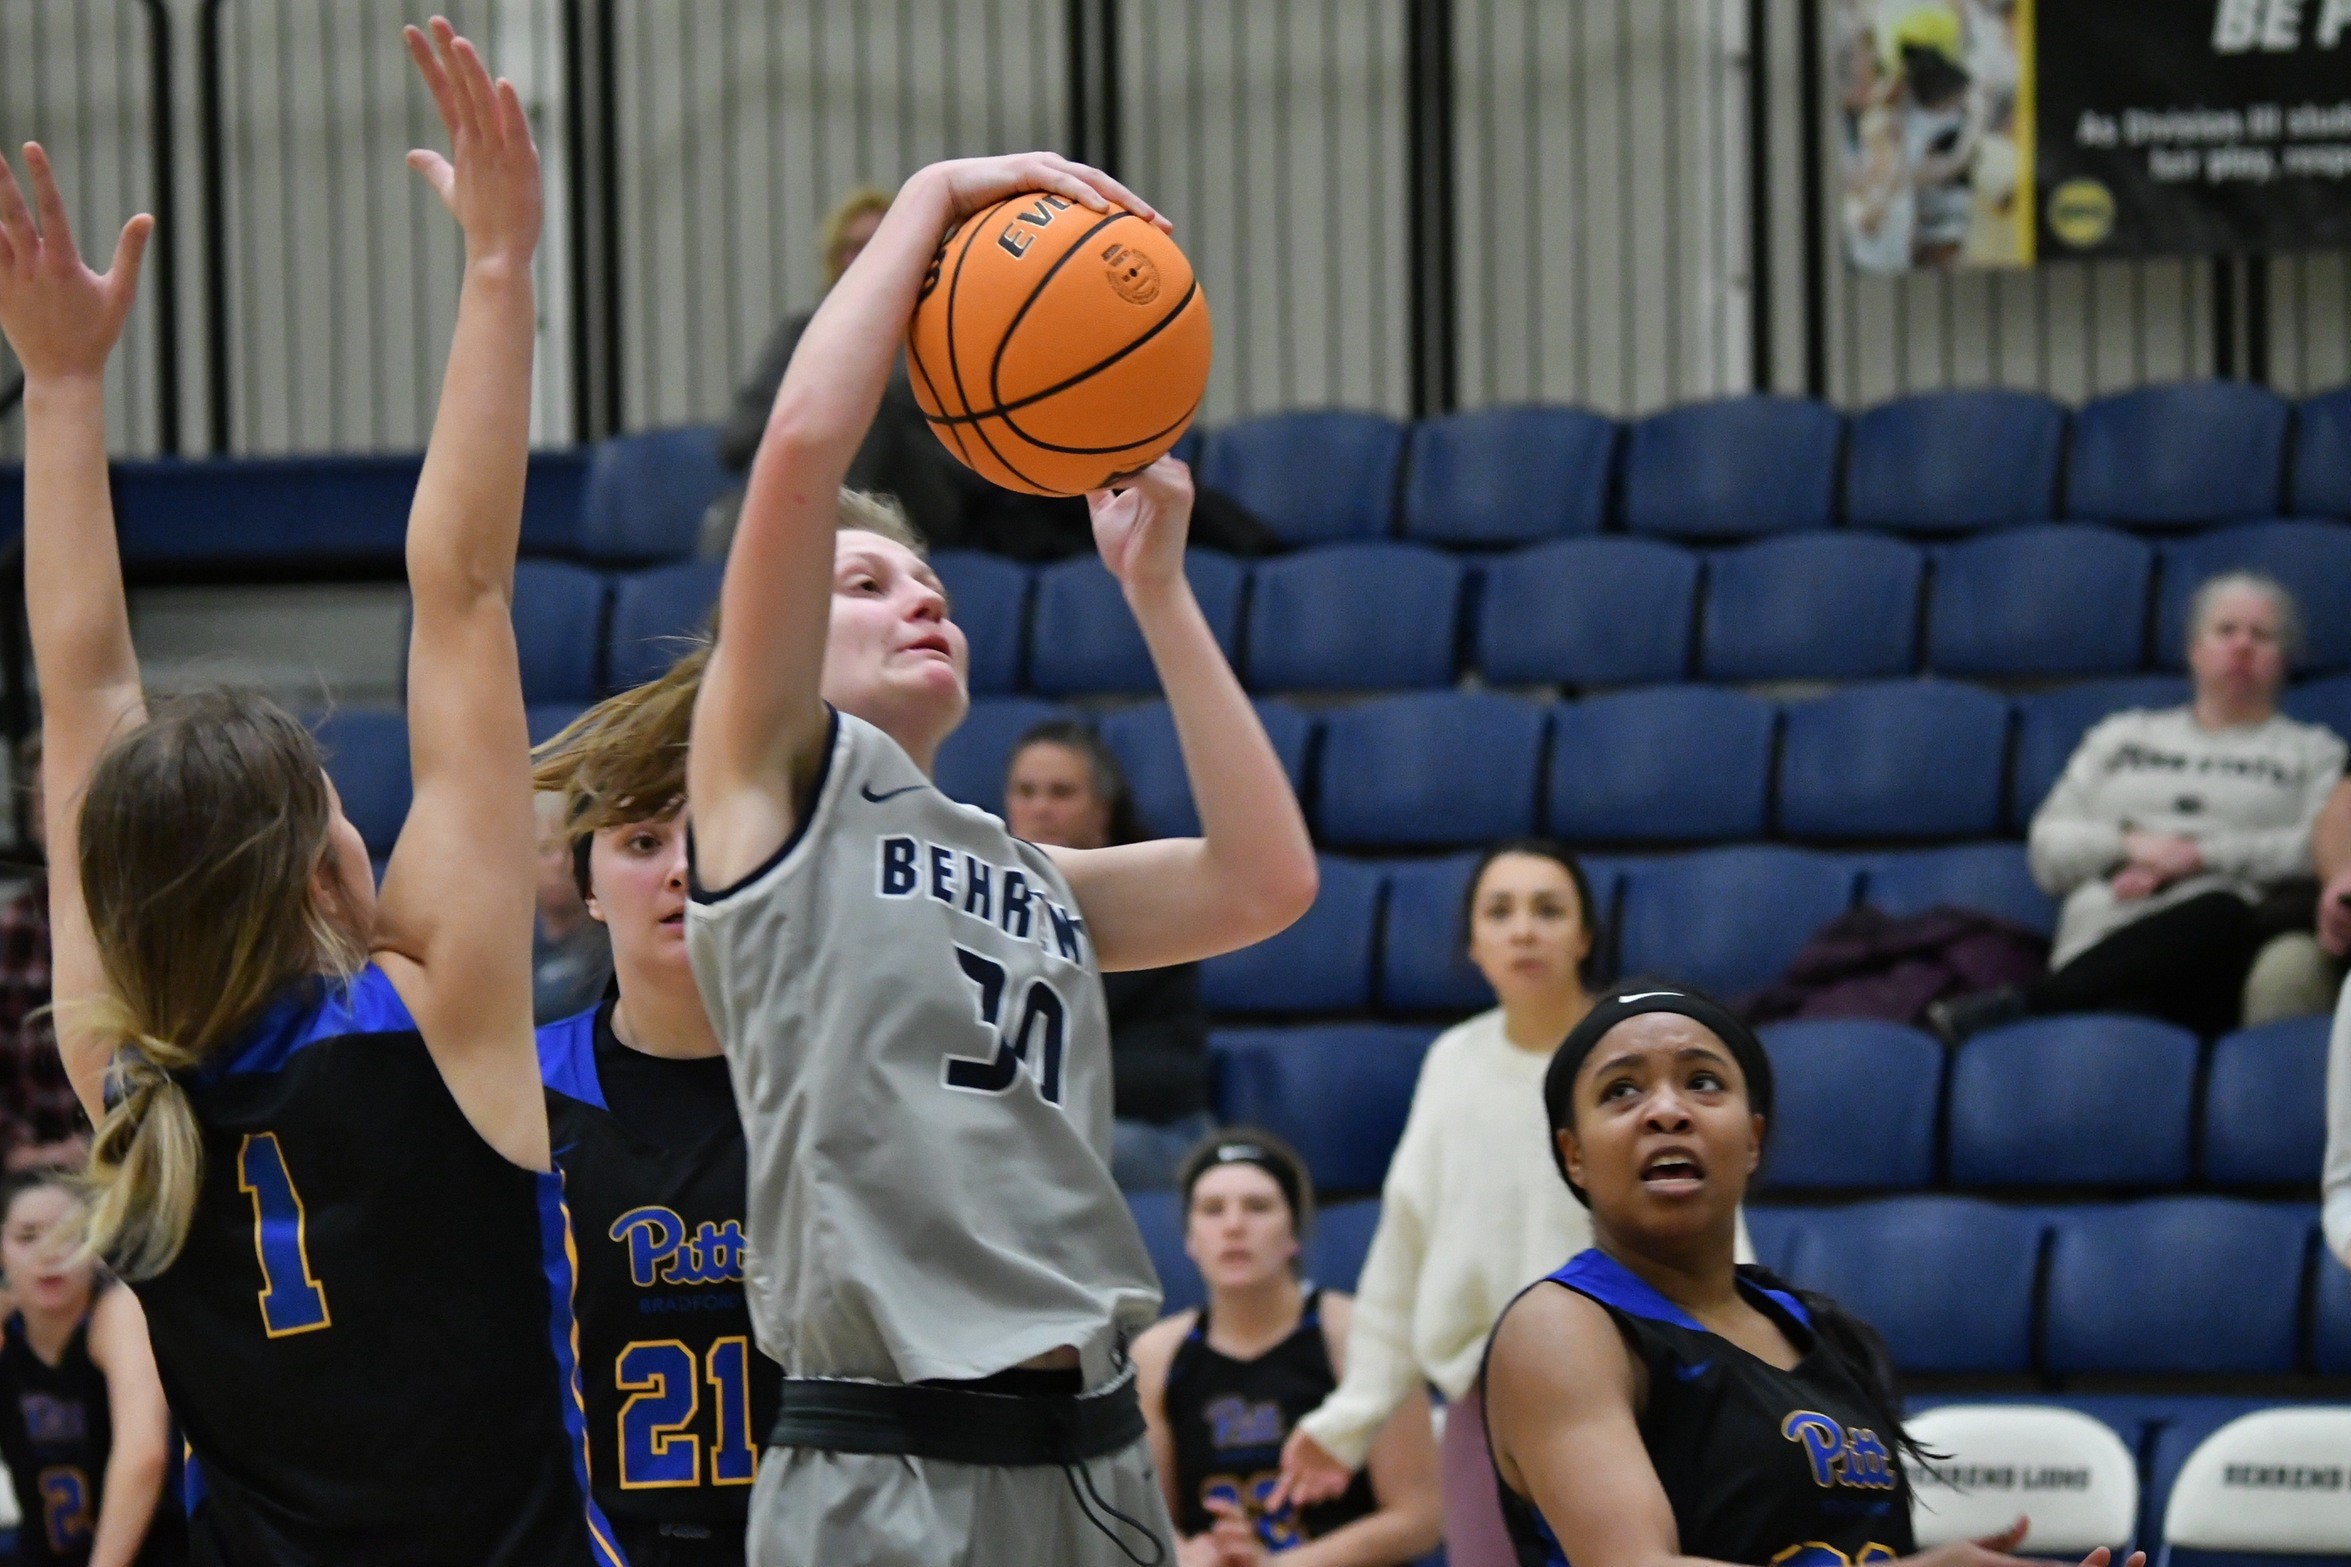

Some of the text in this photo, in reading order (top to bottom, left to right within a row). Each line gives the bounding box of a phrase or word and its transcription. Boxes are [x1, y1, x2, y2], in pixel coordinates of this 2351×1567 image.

[2211, 0, 2300, 53] BE
[940, 940, 1066, 1111] 30
[237, 1131, 332, 1339] 1
[608, 1205, 749, 1288] Pitt
[615, 1335, 759, 1490] 21
[1781, 1409, 1897, 1490] Pitt
